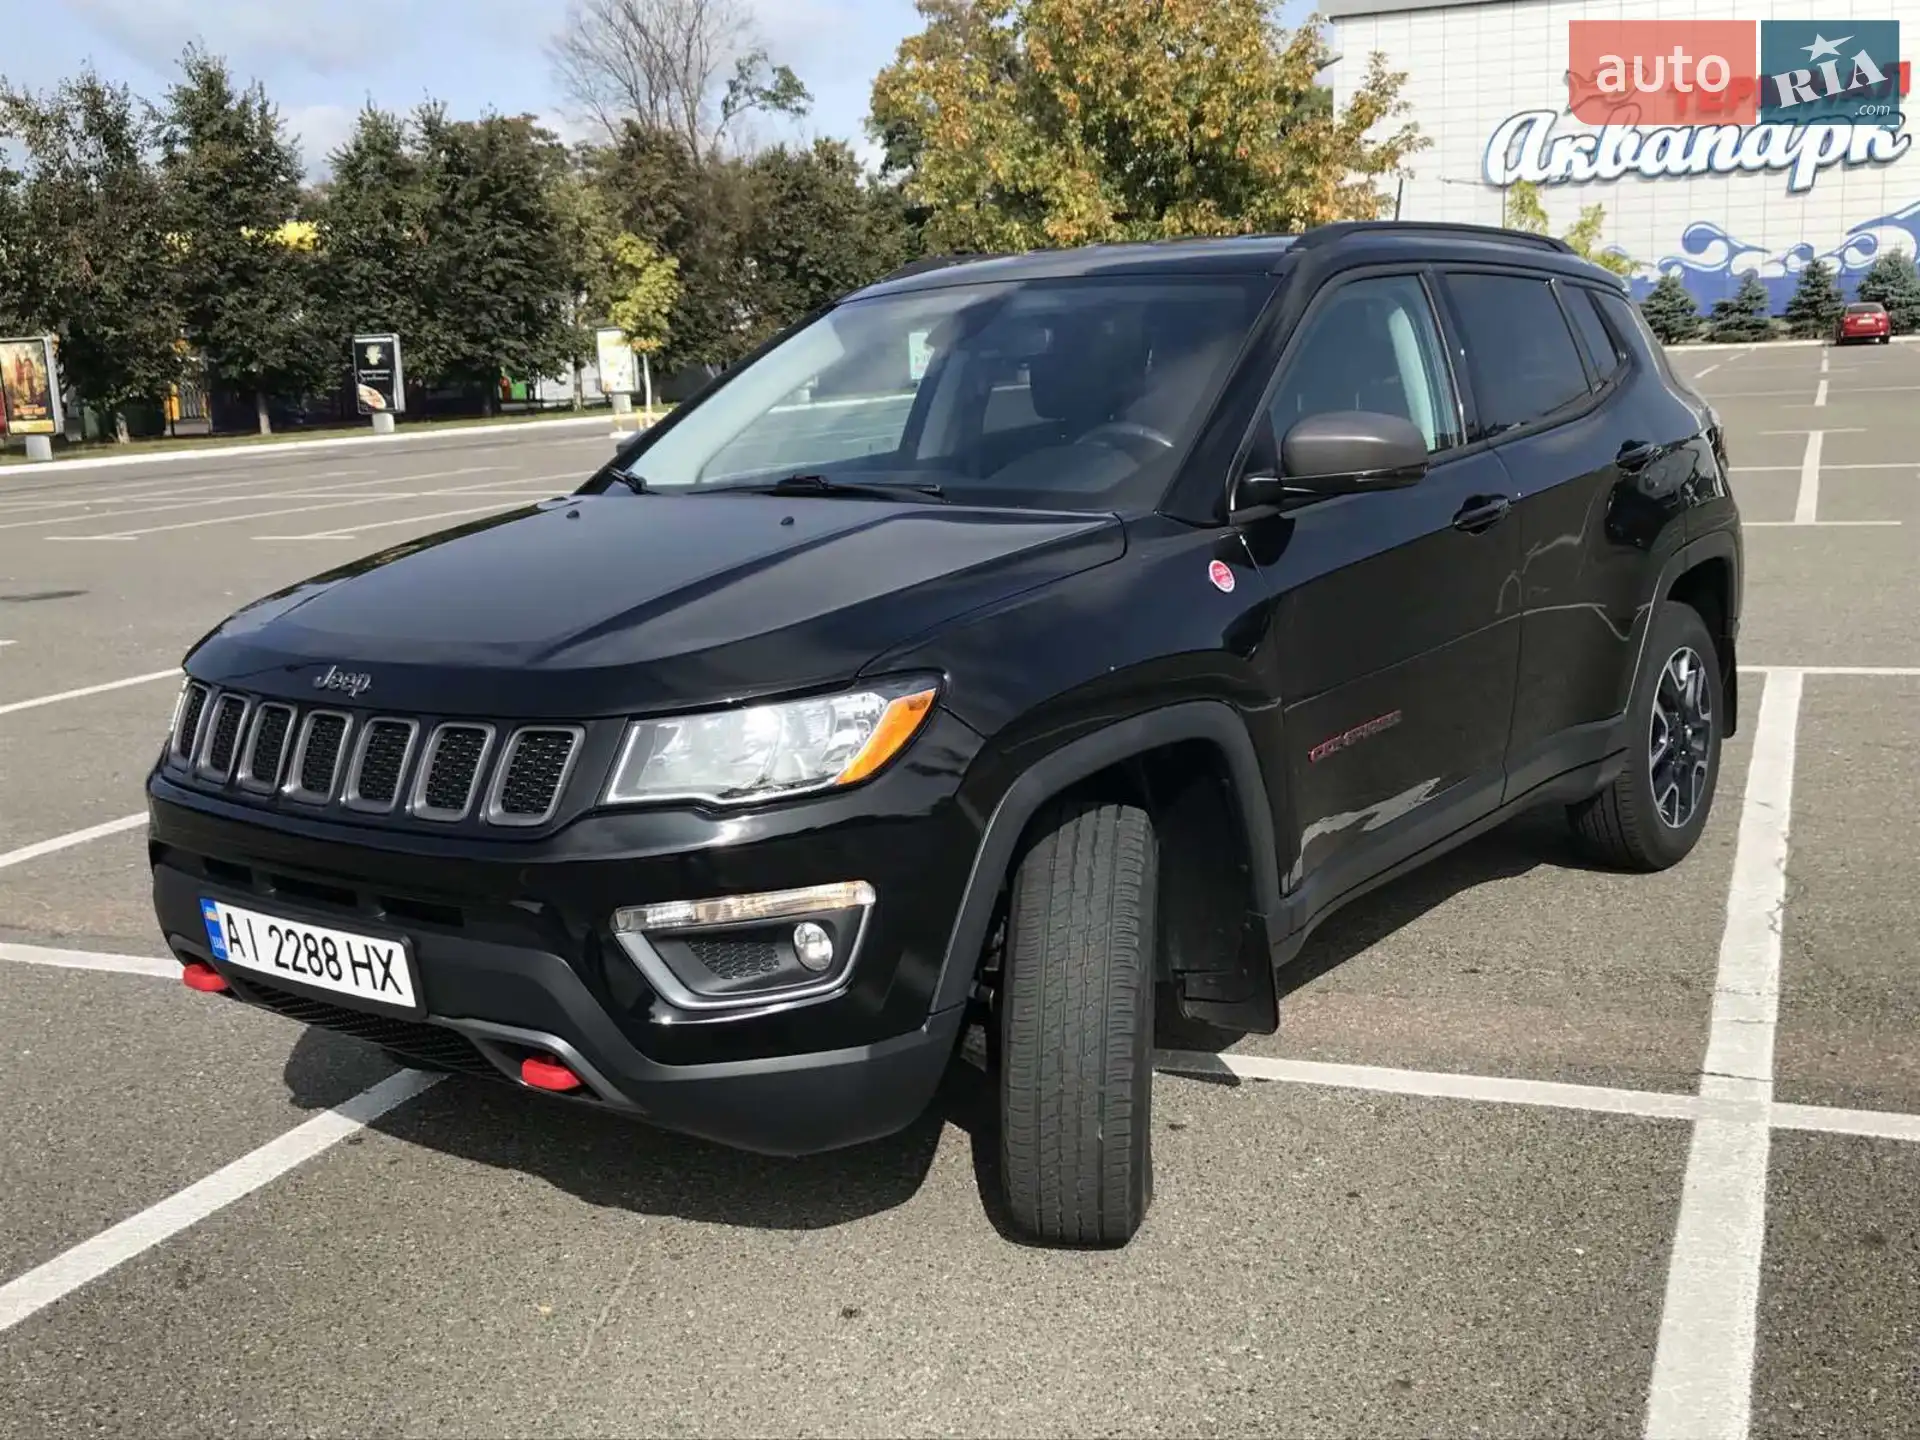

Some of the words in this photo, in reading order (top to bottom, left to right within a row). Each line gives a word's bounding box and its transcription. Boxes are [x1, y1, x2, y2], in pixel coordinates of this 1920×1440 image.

[1484, 104, 1911, 192] Аквапарк
[313, 665, 371, 698] Jeep
[226, 912, 259, 962] AI
[268, 925, 343, 982] 2288
[346, 940, 403, 995] HX
